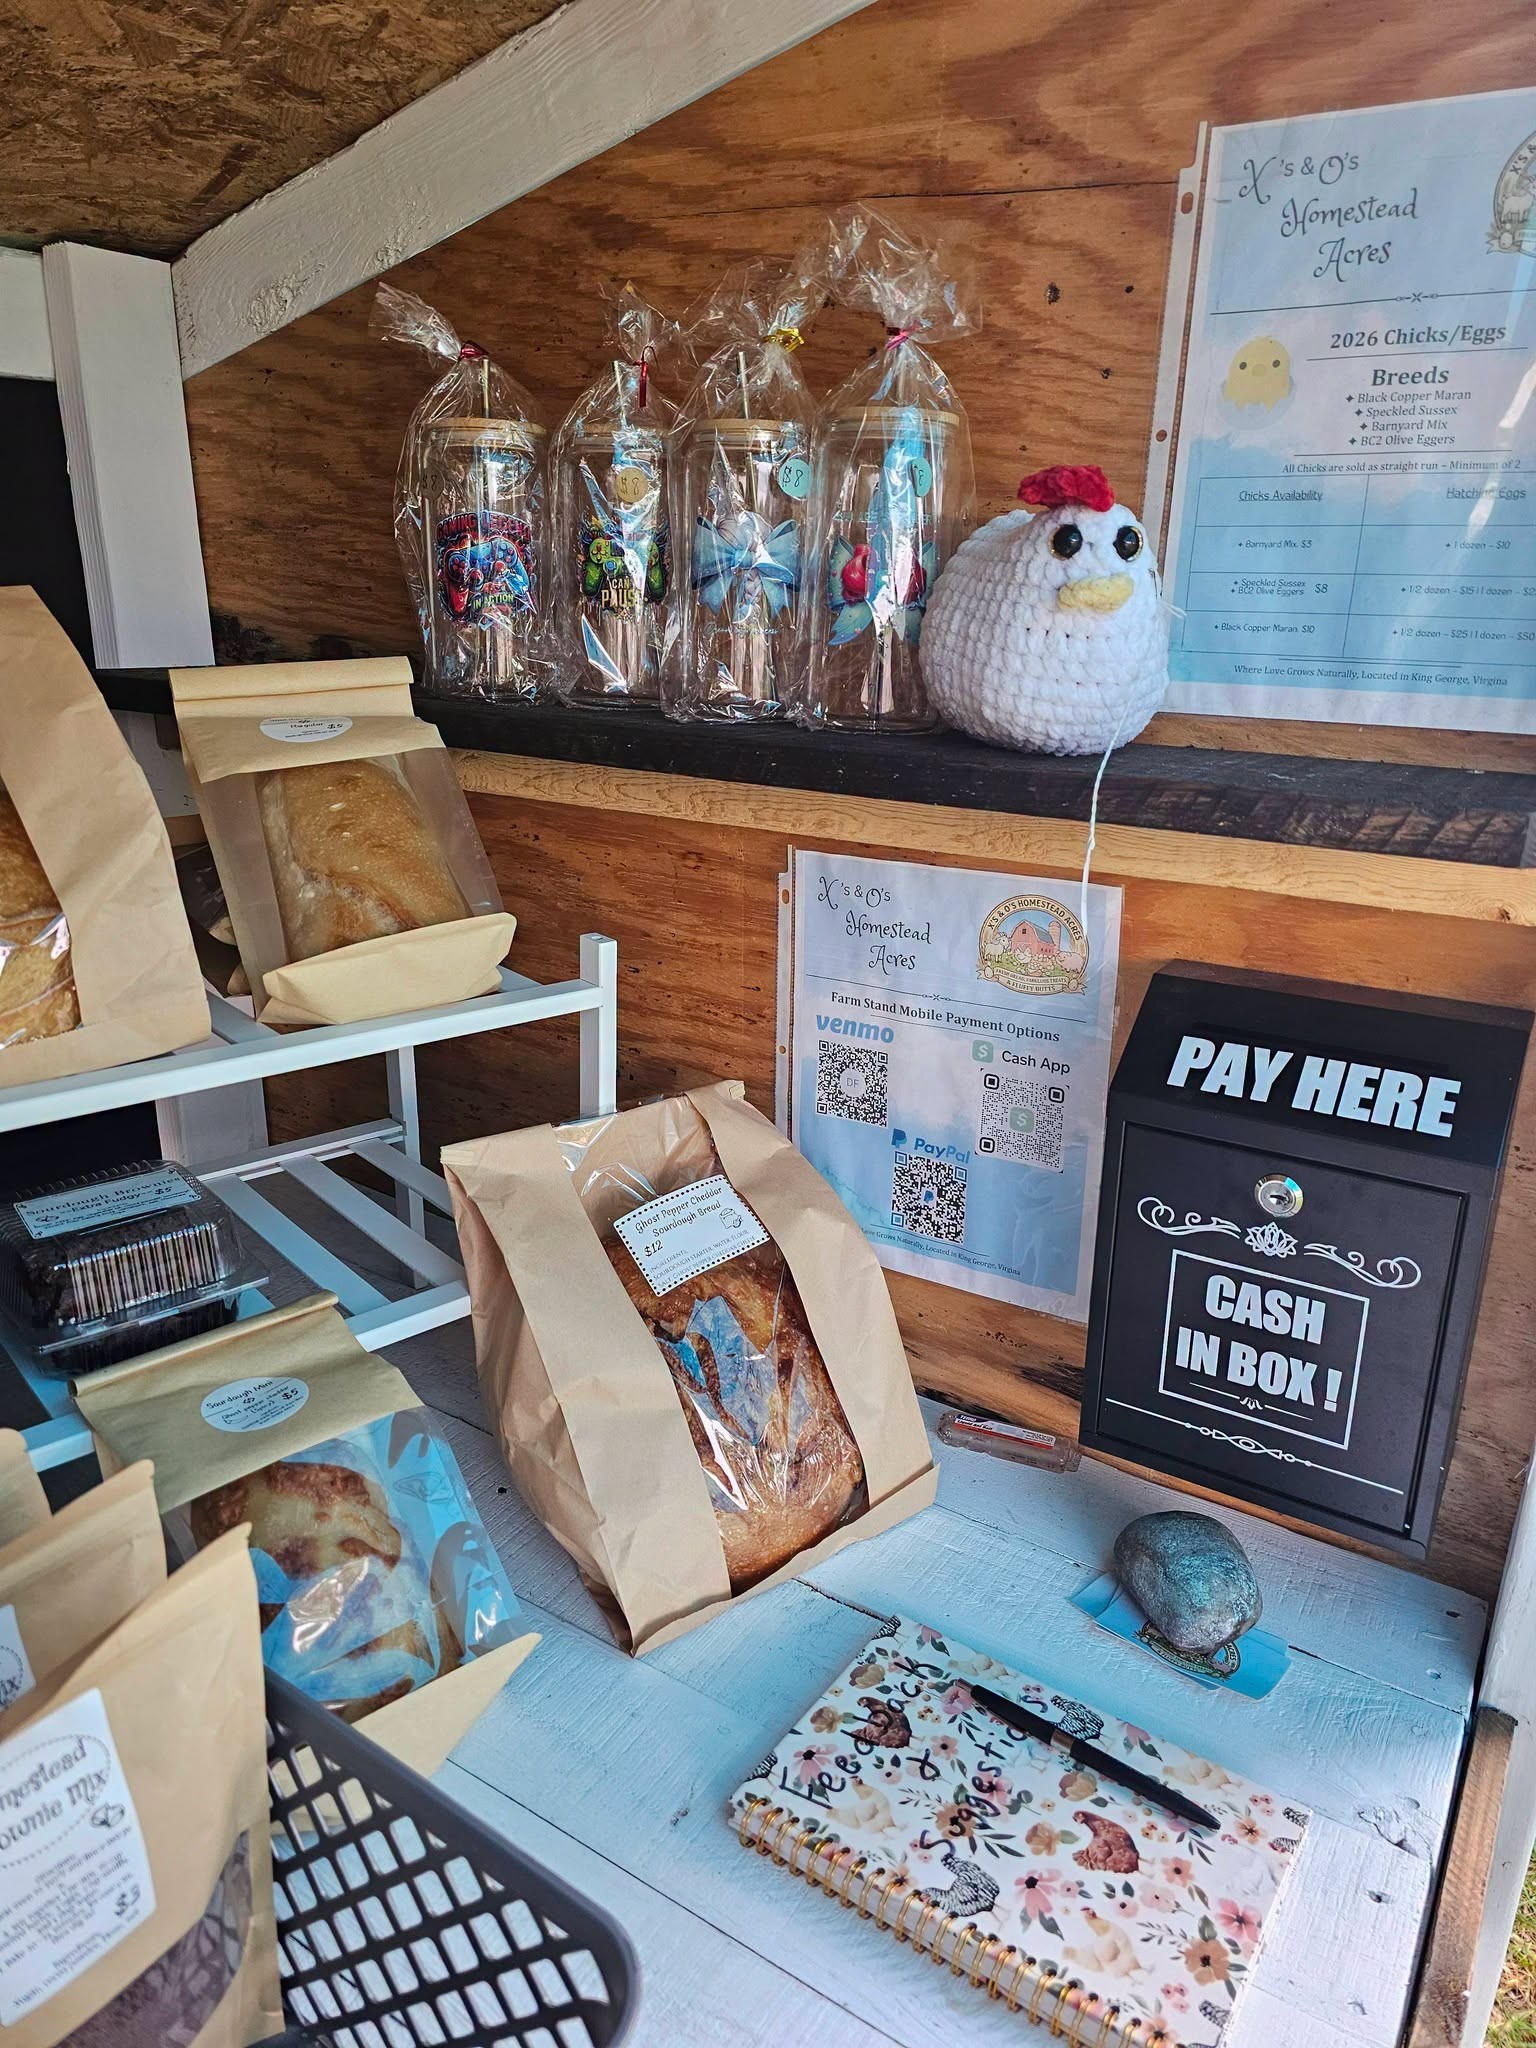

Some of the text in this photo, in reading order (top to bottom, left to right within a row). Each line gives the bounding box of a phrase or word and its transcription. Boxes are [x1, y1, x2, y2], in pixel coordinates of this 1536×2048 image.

[1238, 152, 1359, 204] X's & O's
[1281, 188, 1418, 237] Homestead
[1313, 237, 1392, 282] Acres
[1330, 324, 1506, 348] 2026 Chicks/Eggs
[1371, 366, 1449, 386] Breeds
[1357, 390, 1471, 403] Black Copper Maran
[1366, 406, 1458, 419] Speckled Sussex
[1372, 420, 1448, 433] Barnyard Mix
[1361, 435, 1455, 446] BC2 Olive Eggers
[782, 466, 803, 488] $8
[1283, 465, 1294, 473] All
[1297, 464, 1326, 472] Chicks
[1346, 463, 1366, 471] sold
[1380, 462, 1417, 471] straight
[1450, 461, 1498, 469] Minimum
[1501, 461, 1512, 469] of
[619, 475, 639, 497] $8
[1239, 490, 1323, 501] Chicks Availability
[1499, 487, 1526, 499] Eggs
[1245, 540, 1281, 549] Barnyard
[1460, 541, 1486, 549] dozen
[1496, 541, 1510, 549] $10
[612, 577, 630, 590] CAN
[1238, 587, 1254, 595] BC2
[1277, 588, 1304, 597] Eggers
[1241, 579, 1305, 588] Speckled Sussex
[1315, 583, 1328, 593] $8
[1424, 586, 1450, 594] dozen
[1460, 587, 1474, 595] $15
[1485, 587, 1512, 595] dozen
[1221, 623, 1315, 633] Black Copper Maran $10
[1416, 629, 1440, 637] dozen
[1451, 630, 1468, 638] $25
[1480, 631, 1506, 639] dozen
[1517, 631, 1535, 641] $50
[1234, 665, 1262, 674] Where
[1265, 667, 1284, 675] Love
[1287, 667, 1314, 676] Grows
[1317, 668, 1359, 680] Naturally,
[1361, 672, 1398, 680] Located
[1411, 673, 1433, 683] King
[1435, 674, 1470, 685] George,
[1473, 676, 1508, 686] Virgina
[818, 877, 890, 909] X's & O's
[846, 910, 931, 944] Homestead
[988, 916, 998, 930] X'S
[1005, 902, 1017, 912] O'S
[1018, 900, 1065, 917] HOMESTEAD
[1065, 917, 1082, 940] ACRES
[868, 945, 916, 975] Acres
[831, 992, 1060, 1042] Farm Stand Mobile Payment Options
[815, 1015, 894, 1043] venmo
[1002, 1051, 1070, 1075] Cash App
[846, 1077, 860, 1088] DF
[1167, 1036, 1461, 1138] PAY HERE
[914, 1137, 970, 1164] PayPal
[26, 1192, 109, 1215] Sourdough
[115, 1177, 180, 1196] Brownies
[635, 1188, 722, 1234] Ghost Pepper Cheddar
[653, 1200, 721, 1237] Sourdough Bread
[644, 1240, 663, 1256] $12
[876, 1231, 896, 1240] Grows
[897, 1235, 924, 1250] Naturally,
[926, 1244, 949, 1256] Located
[951, 1249, 957, 1257] in
[958, 1252, 972, 1263] King
[972, 1257, 997, 1269] George,
[998, 1263, 1021, 1275] Virgina
[1205, 1274, 1326, 1344] CASH
[1176, 1327, 1342, 1412] IN BOX !
[206, 1390, 252, 1409] Sourdough
[282, 1388, 298, 1400] $5
[779, 1656, 928, 1810] Feedback
[919, 1696, 1049, 1856] Suggestios
